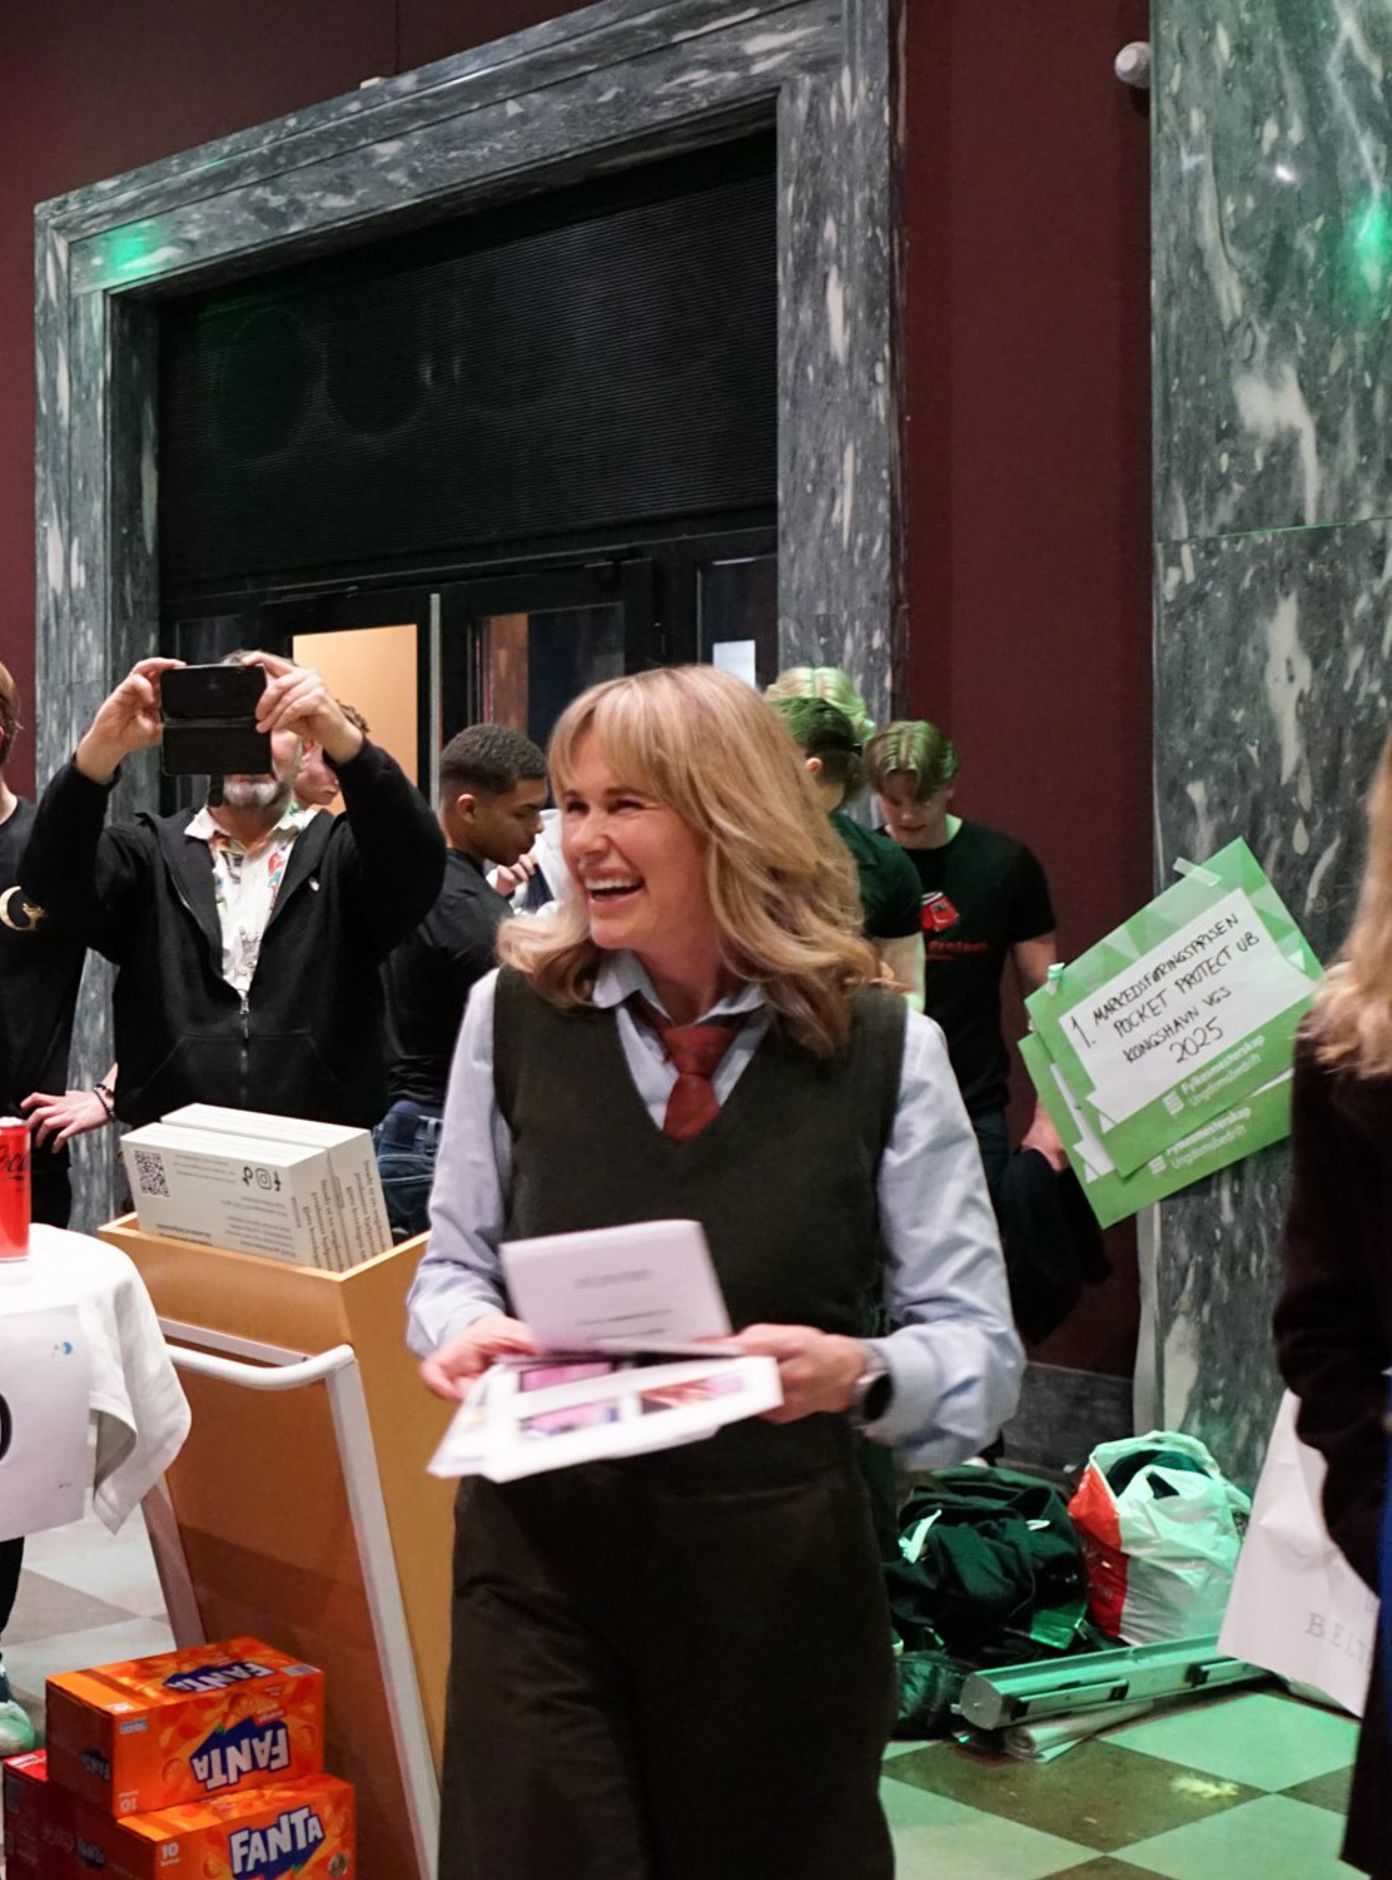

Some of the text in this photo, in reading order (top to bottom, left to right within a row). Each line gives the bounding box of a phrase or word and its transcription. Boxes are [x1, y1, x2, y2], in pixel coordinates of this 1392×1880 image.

[1114, 930, 1261, 1039] POCKET PROTECT UB
[1123, 986, 1232, 1063] KONGSHAVN VGS
[1169, 1015, 1224, 1064] 2025
[164, 1660, 276, 1693] FANTA
[191, 1727, 290, 1791] FANTA
[230, 1806, 324, 1875] FANTA
